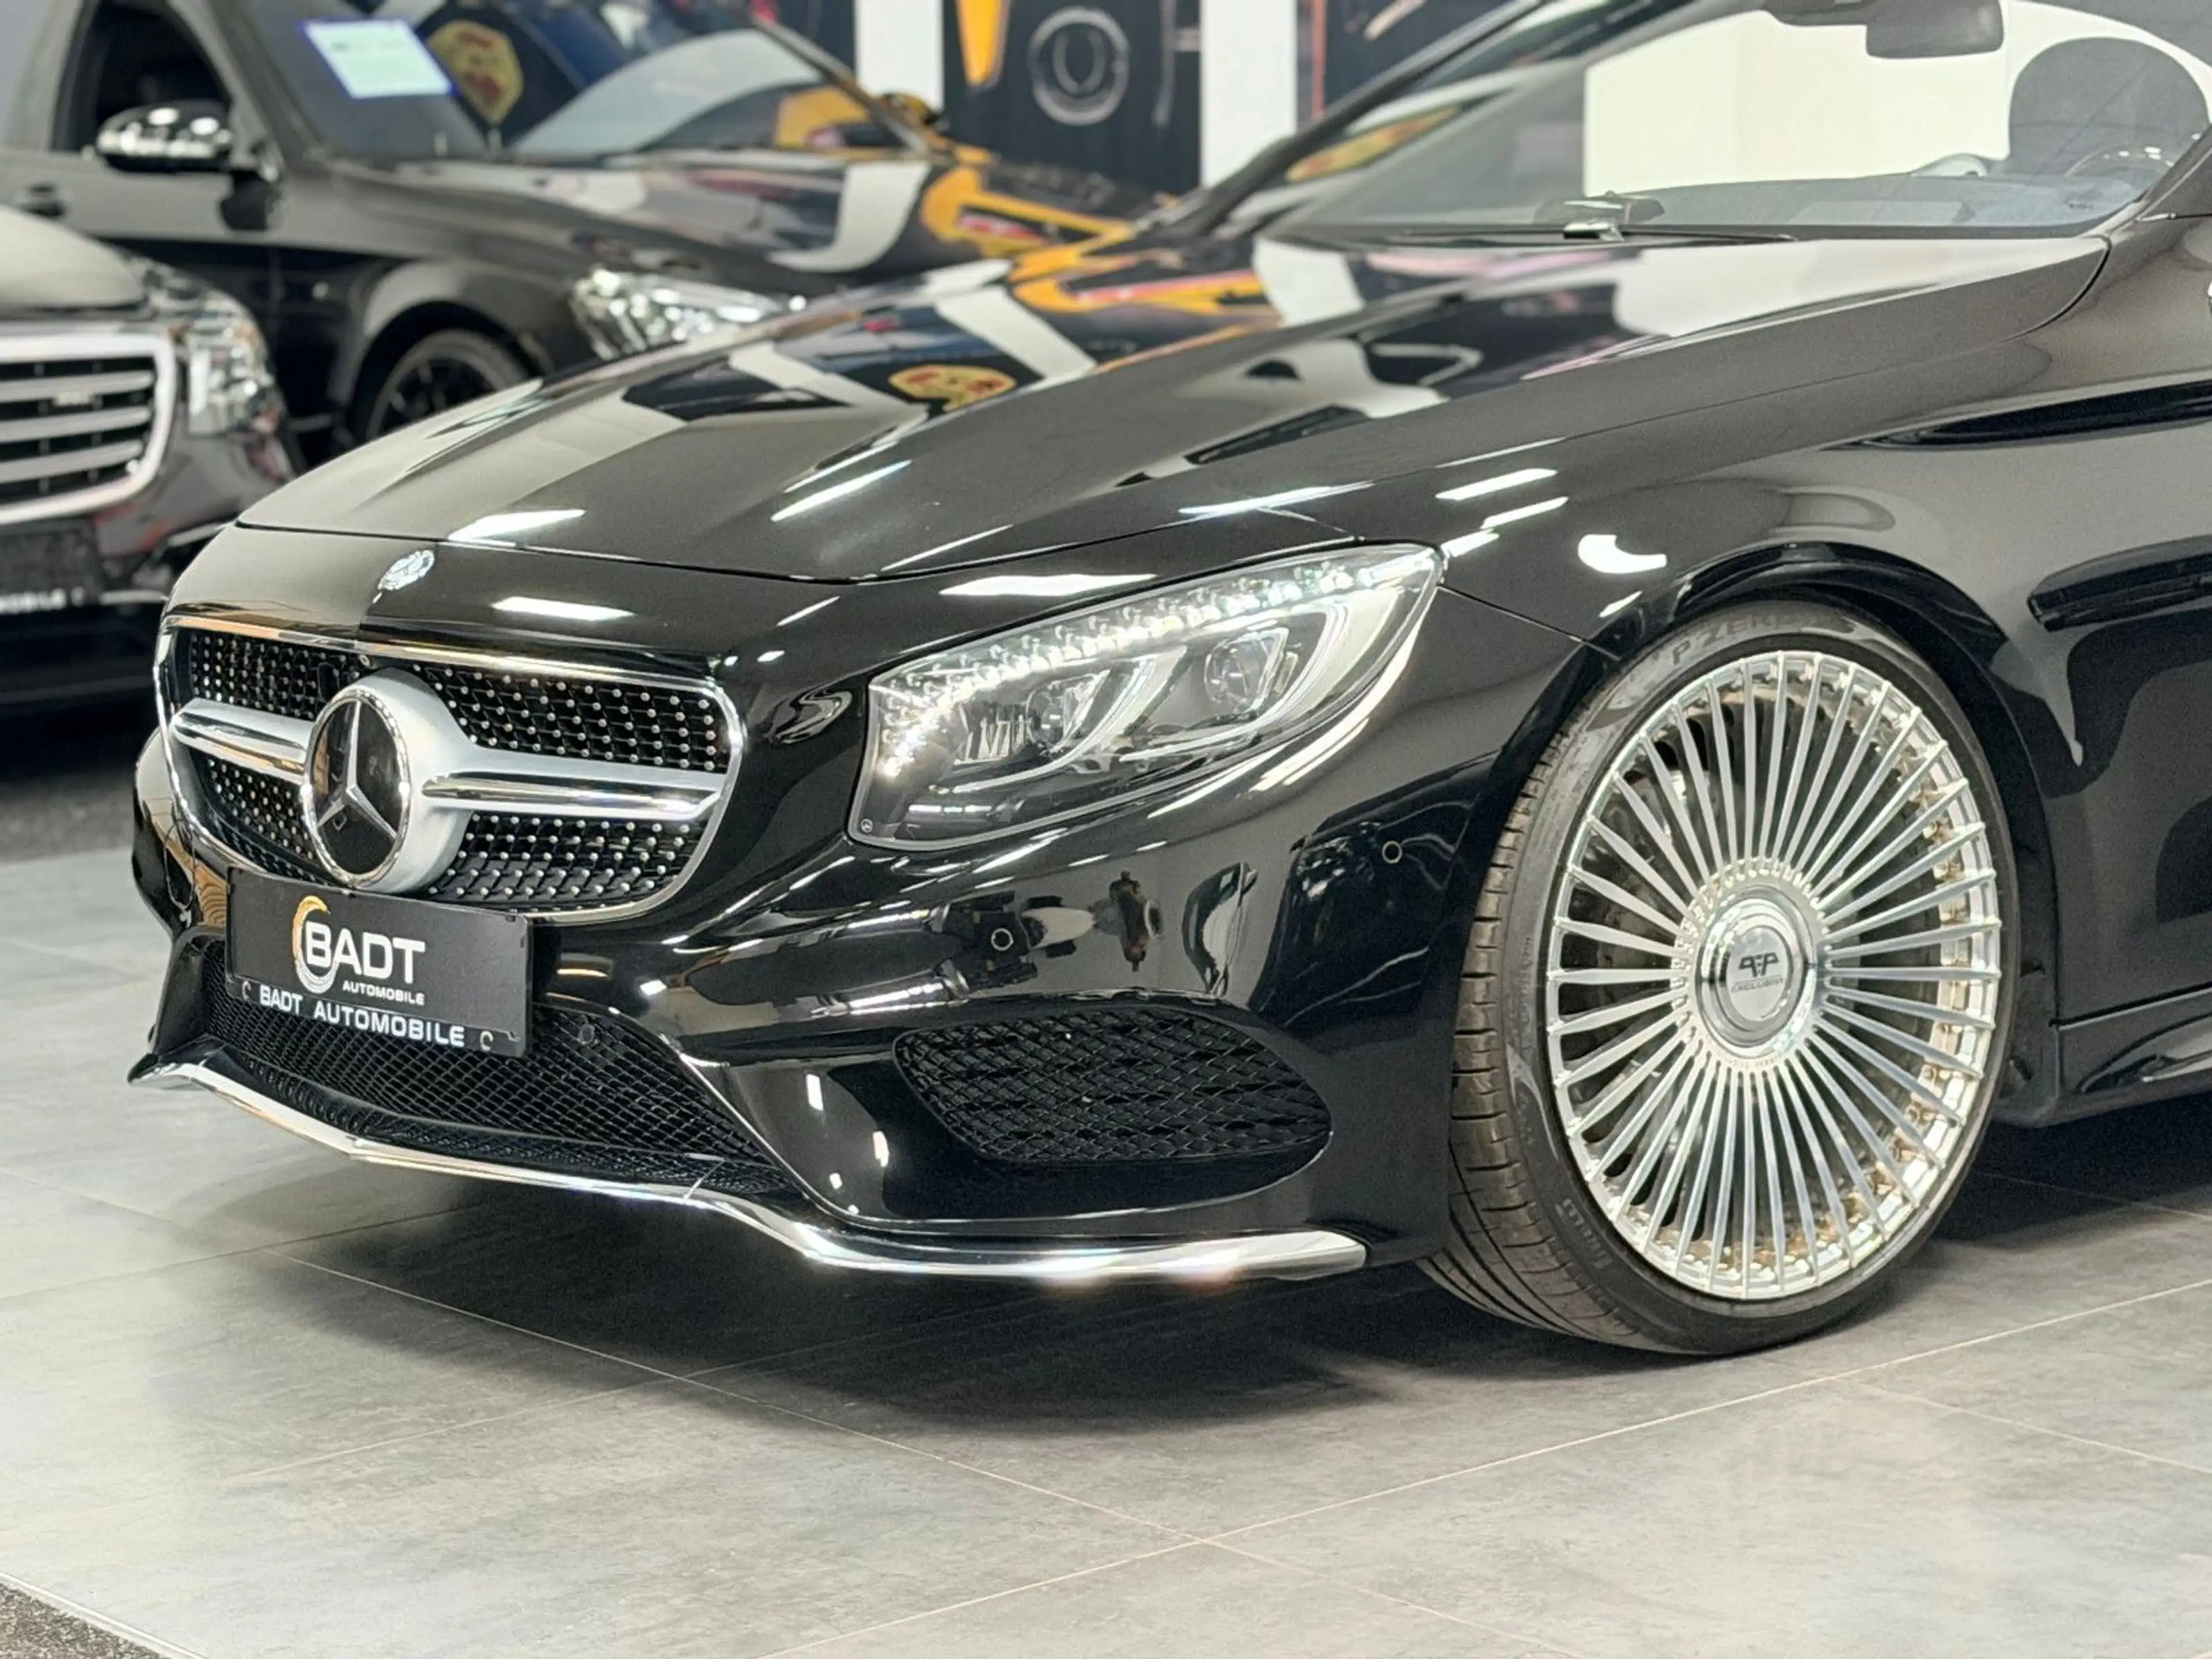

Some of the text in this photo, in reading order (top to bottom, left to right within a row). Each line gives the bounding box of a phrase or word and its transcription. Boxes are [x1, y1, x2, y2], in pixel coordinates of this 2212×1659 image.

[305, 921, 426, 984] BADT
[259, 984, 465, 1047] BADT AUTOMOBILE
[342, 980, 425, 1006] AUTOMOBILE
